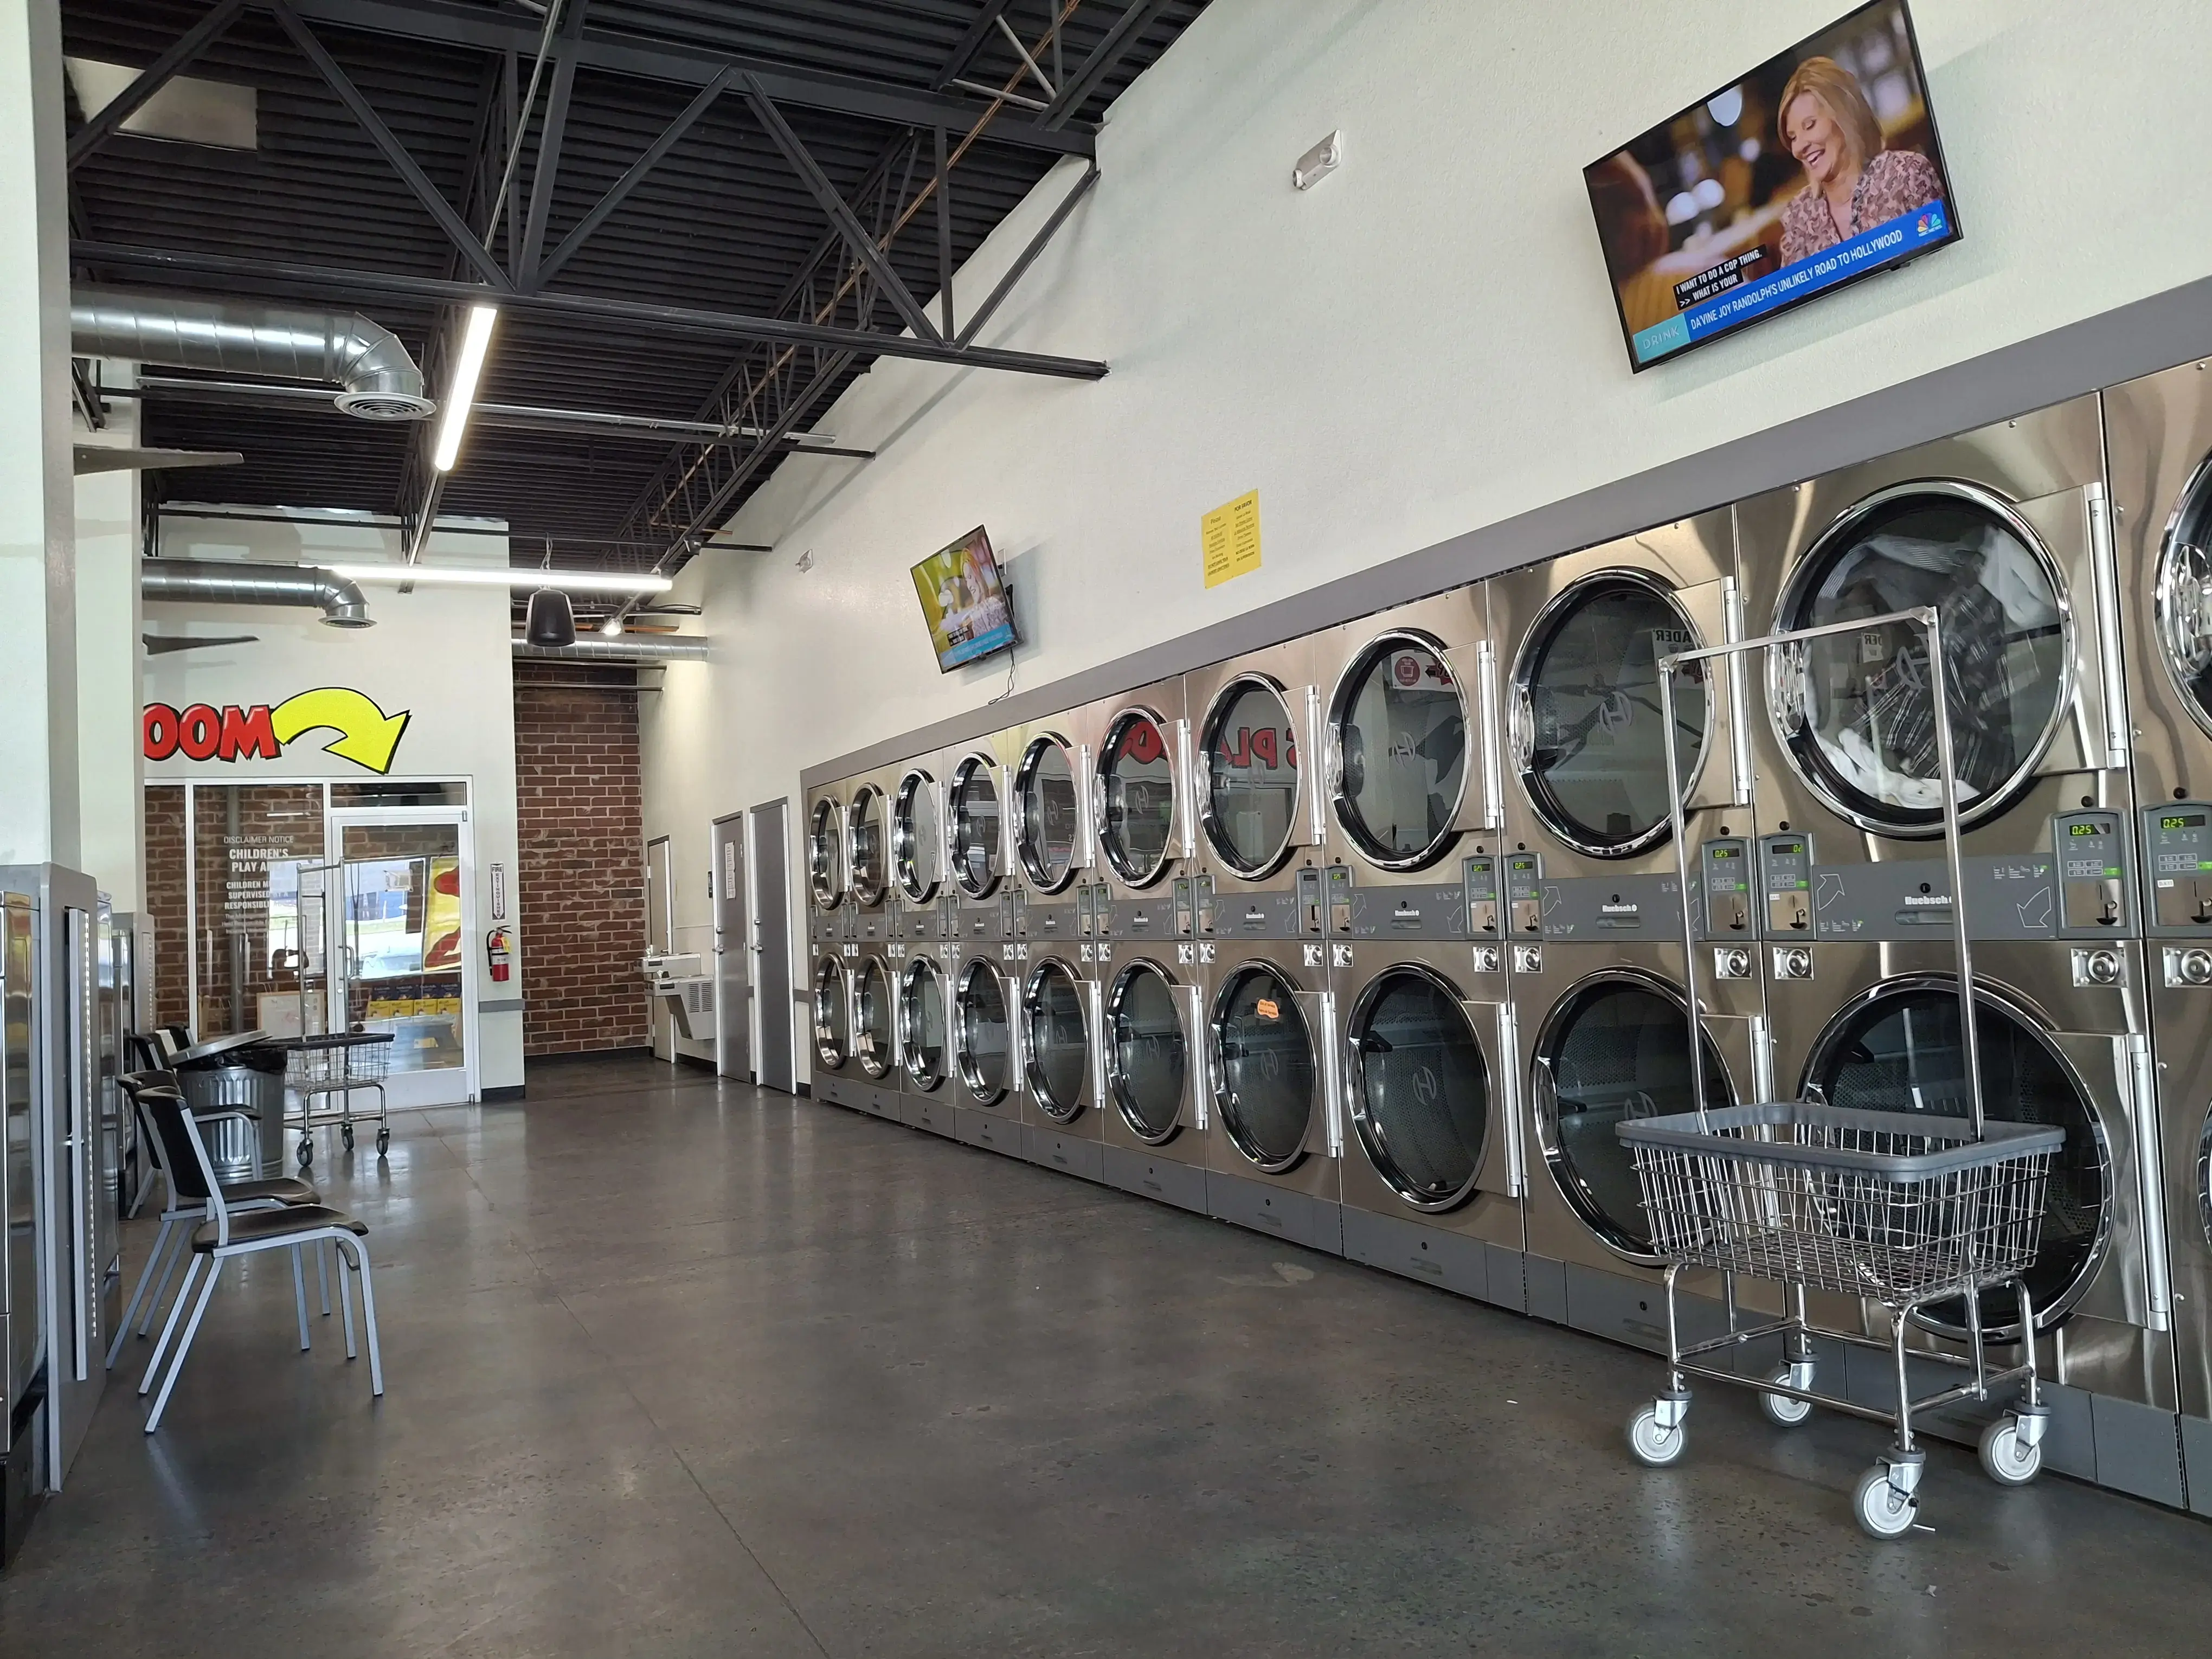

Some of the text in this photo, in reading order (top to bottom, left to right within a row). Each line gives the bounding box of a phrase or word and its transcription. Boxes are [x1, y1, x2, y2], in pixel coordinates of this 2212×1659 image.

[1676, 249, 1762, 294] I WANT TO DO A COP THING.
[1690, 230, 1902, 330] DA'VINE JOY RANDOLPH'S UNLIKELY ROAD TO HOLLYWOOD
[1692, 288, 1711, 301] WHAT
[1712, 284, 1719, 293] IS
[1719, 274, 1738, 288] YOUR
[1643, 325, 1679, 349] DRINK
[223, 835, 294, 844] DISCLAIMER NOTICE
[229, 848, 288, 860] CHILDREN'S
[232, 862, 259, 872] PLAY
[226, 881, 260, 889] CHILDREN
[228, 891, 270, 899] SUPERVISED
